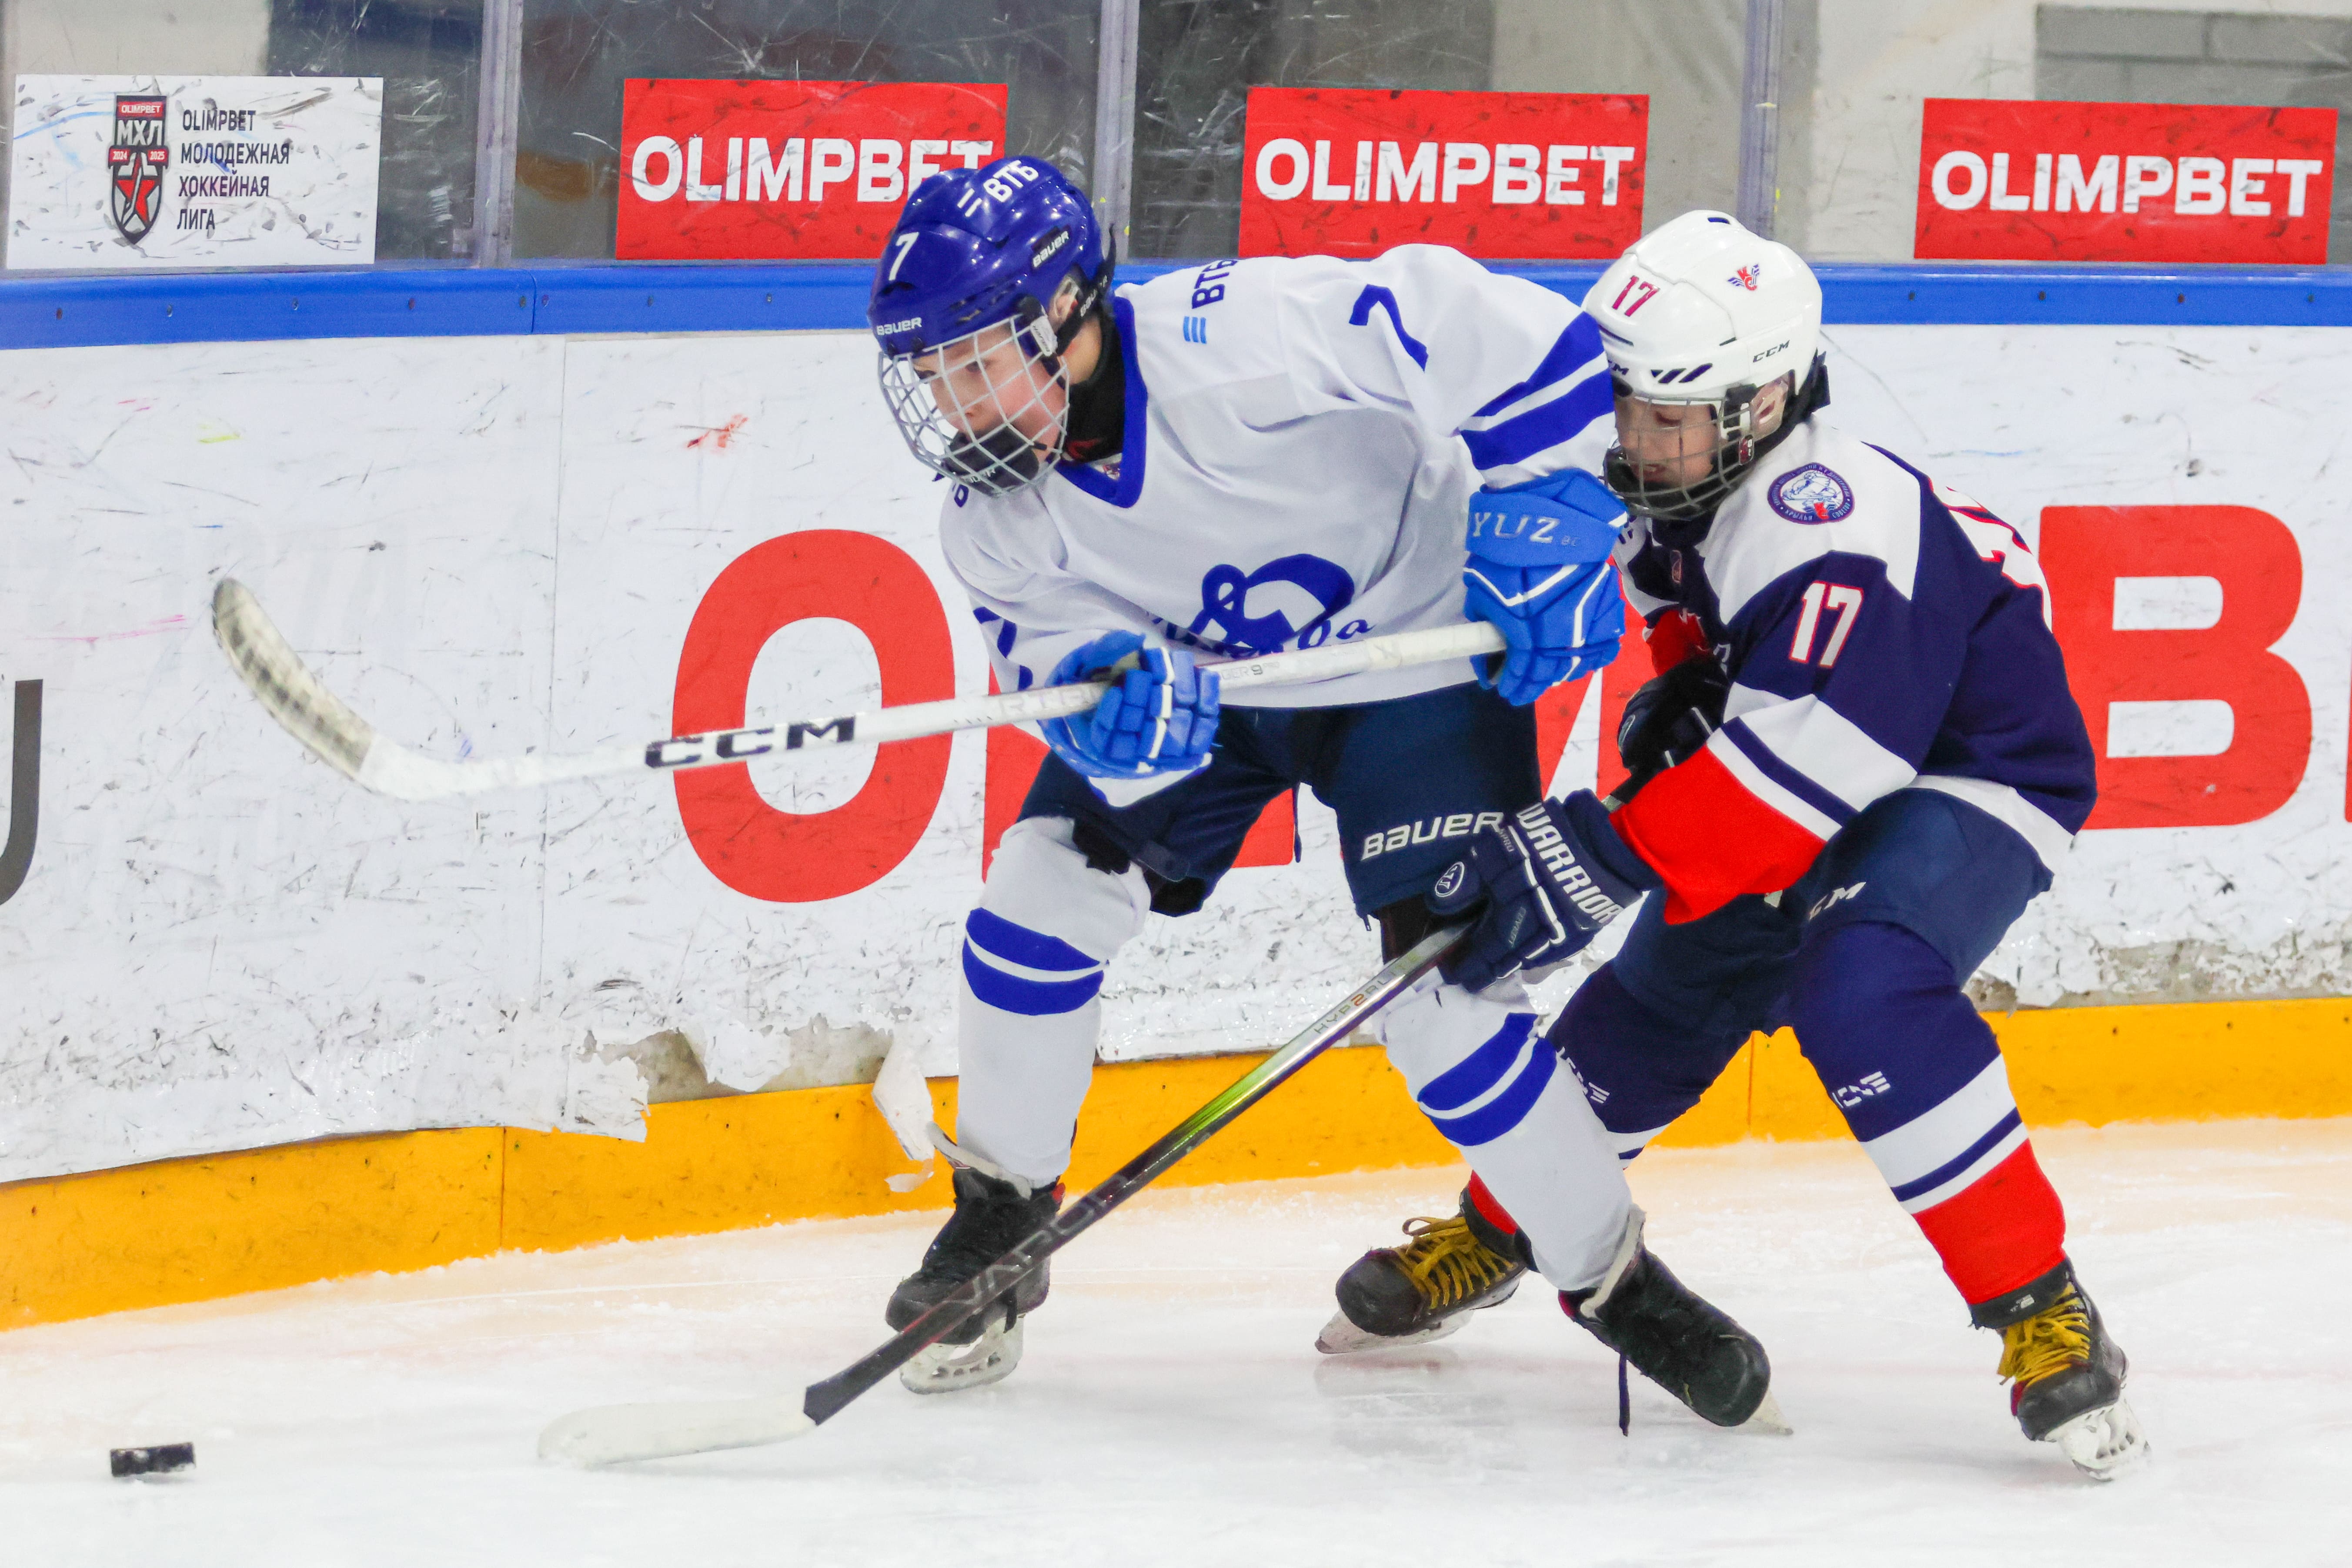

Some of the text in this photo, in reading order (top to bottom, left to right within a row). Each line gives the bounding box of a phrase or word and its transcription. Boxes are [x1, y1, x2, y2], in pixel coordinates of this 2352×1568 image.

[121, 104, 161, 114] OLIMPBET
[182, 110, 256, 131] OLIMPBET
[117, 120, 164, 147] МХЛ
[113, 150, 165, 161] 2024 2025
[181, 143, 289, 167] МОЛОДЕЖНАЯ
[1255, 138, 1635, 206] OLIMPBET
[178, 171, 270, 197] ХОККЕЙНАЯ
[983, 160, 1039, 203] ВТБ
[1931, 150, 2323, 217] OLIMPBET
[177, 209, 216, 230] ЛИГА
[889, 231, 919, 281] 7
[1032, 231, 1069, 267] BAUER
[1611, 275, 1660, 317] 17
[876, 317, 922, 336] BAUER
[1753, 339, 1791, 363] CCM
[1473, 512, 1560, 544] YUZ
[1789, 580, 1864, 669] 17
[645, 715, 857, 769] CCM
[1360, 811, 1504, 862] BAUER
[1516, 802, 1624, 925] WARRIOR
